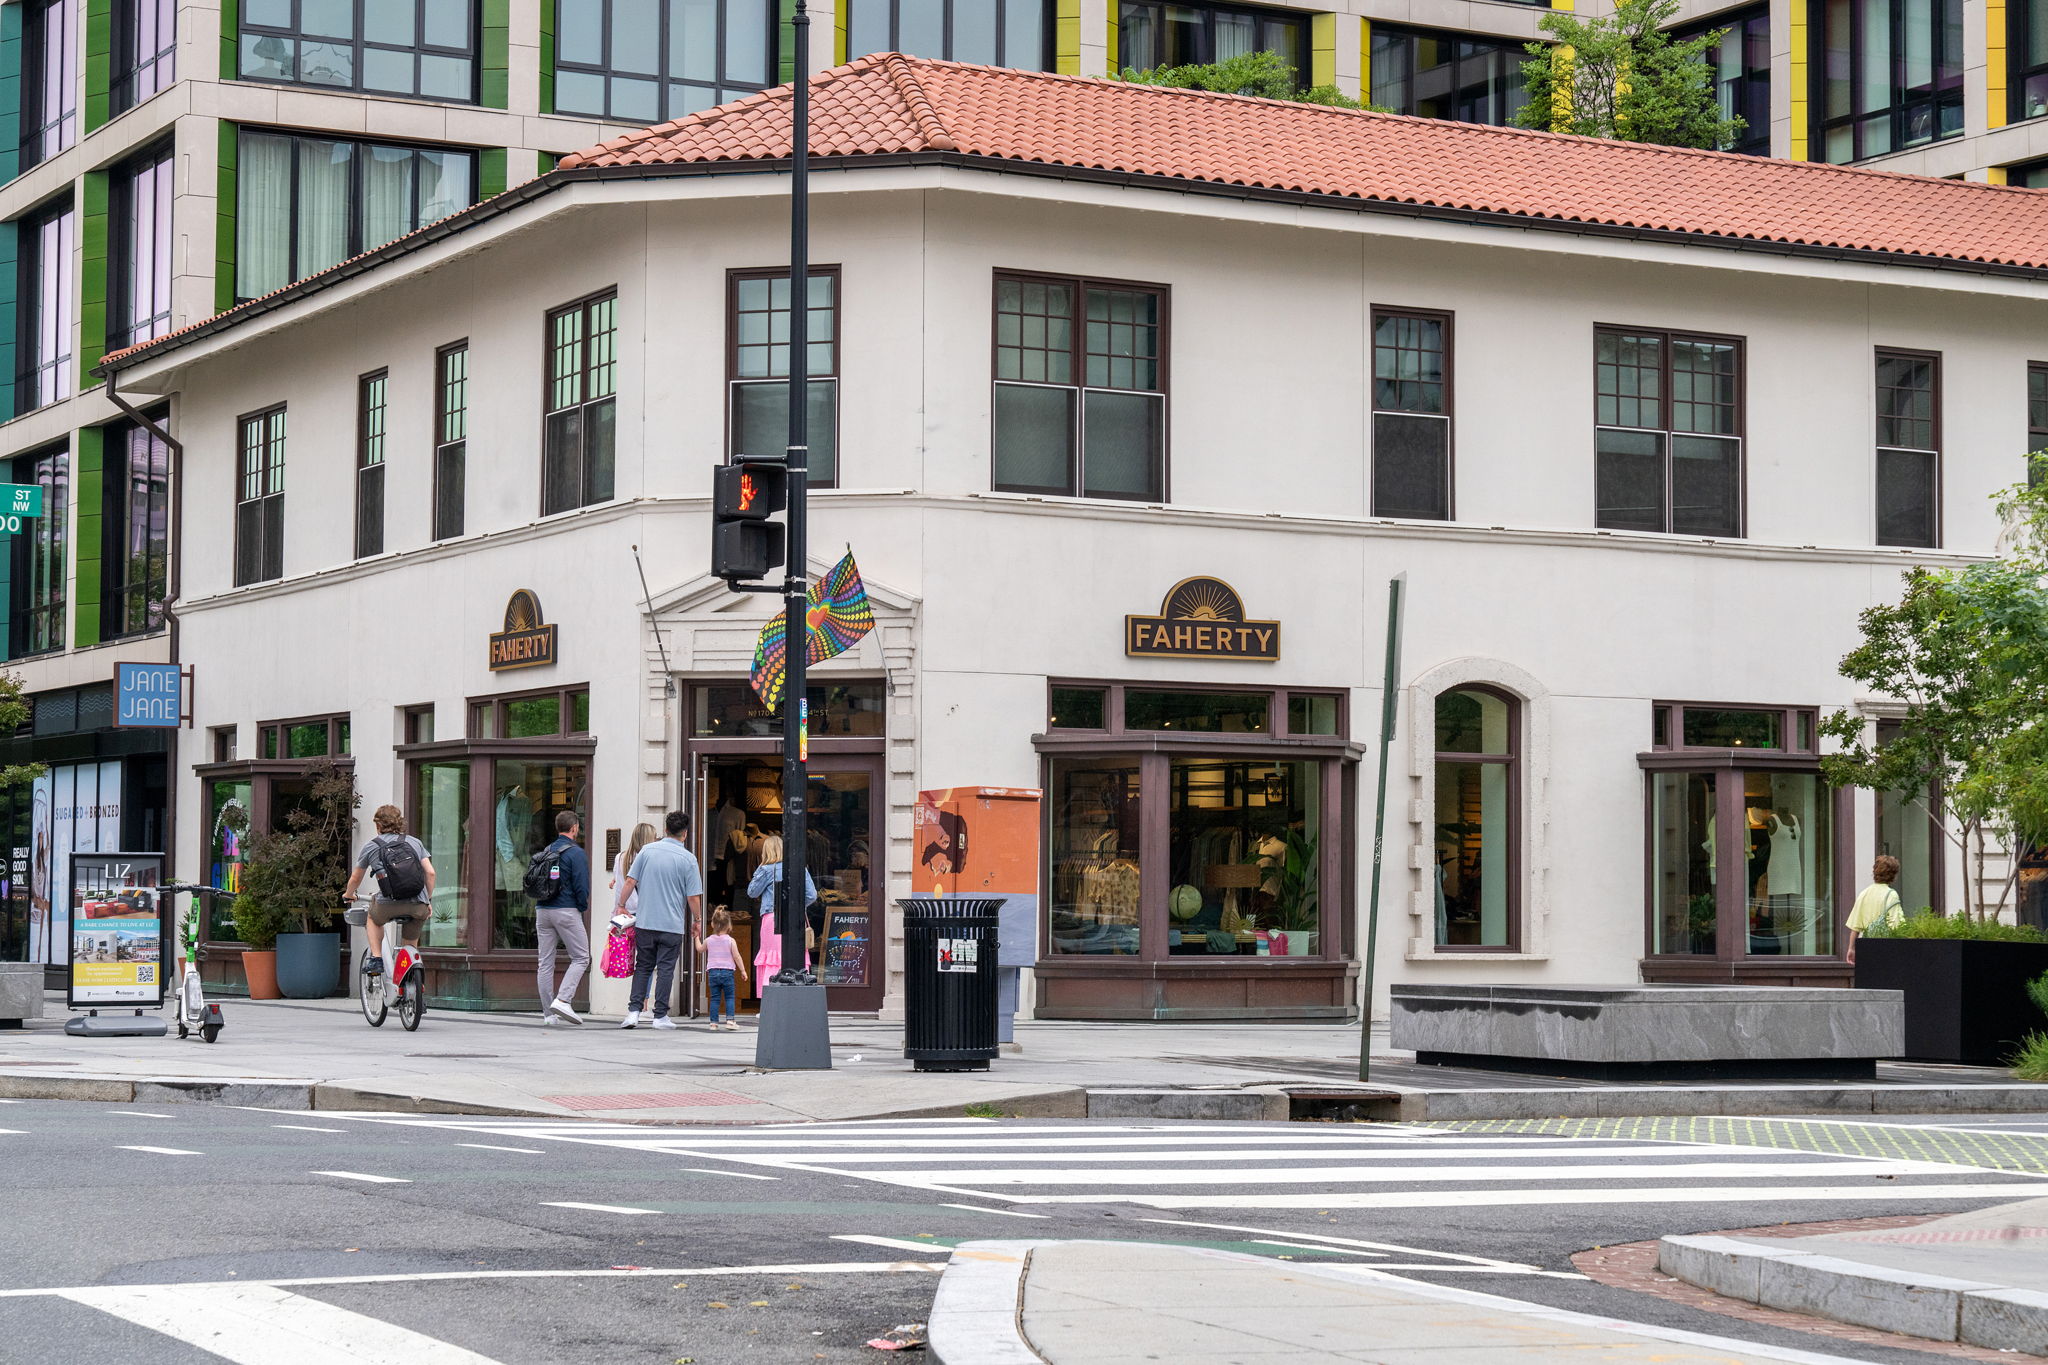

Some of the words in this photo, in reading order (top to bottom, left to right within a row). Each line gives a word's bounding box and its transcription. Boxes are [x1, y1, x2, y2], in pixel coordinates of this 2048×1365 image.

[15, 489, 32, 501] ST
[12, 501, 30, 512] NW
[1136, 623, 1273, 652] FAHERTY
[491, 632, 550, 664] FAHERTY
[123, 670, 177, 693] JANE
[122, 697, 176, 720] JANE
[801, 699, 808, 717] BE
[55, 805, 84, 821] SUGAED
[223, 825, 241, 857] BE
[13, 847, 30, 859] REALLY
[12, 860, 27, 872] GOOD
[105, 863, 131, 879] LIZ
[833, 916, 869, 925] FAHERTY
